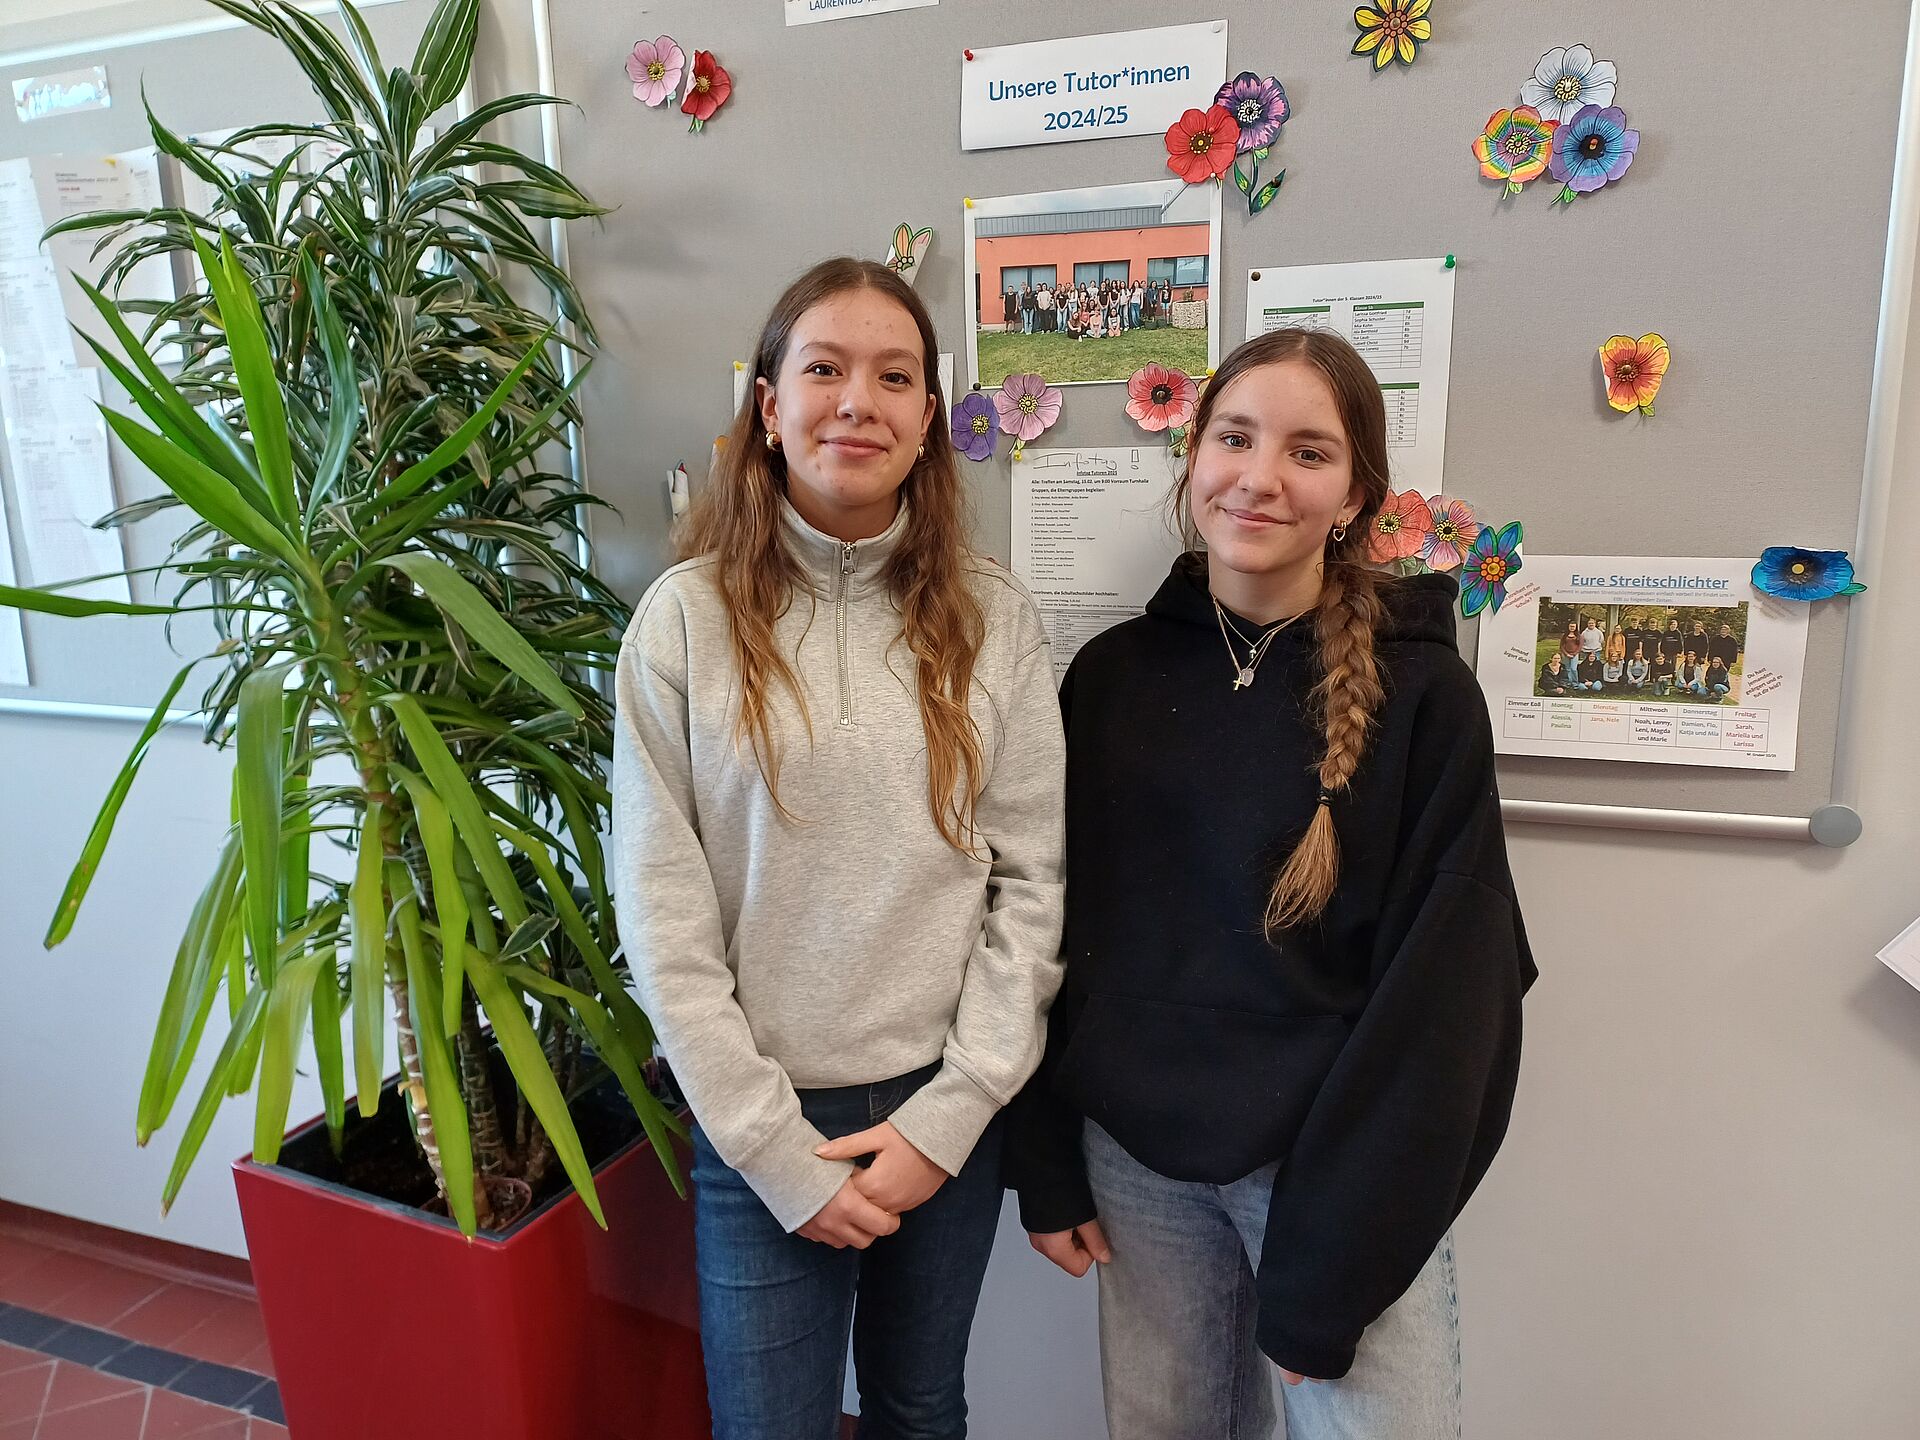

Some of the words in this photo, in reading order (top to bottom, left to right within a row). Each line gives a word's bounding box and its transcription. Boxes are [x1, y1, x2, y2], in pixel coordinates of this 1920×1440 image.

[988, 79, 1057, 101] Unsere
[1044, 105, 1128, 131] 2024/25
[1033, 453, 1117, 470] Infotag
[1570, 574, 1606, 587] Eure
[1610, 575, 1728, 589] Streitschlichter
[1682, 708, 1718, 716] Donnerstag
